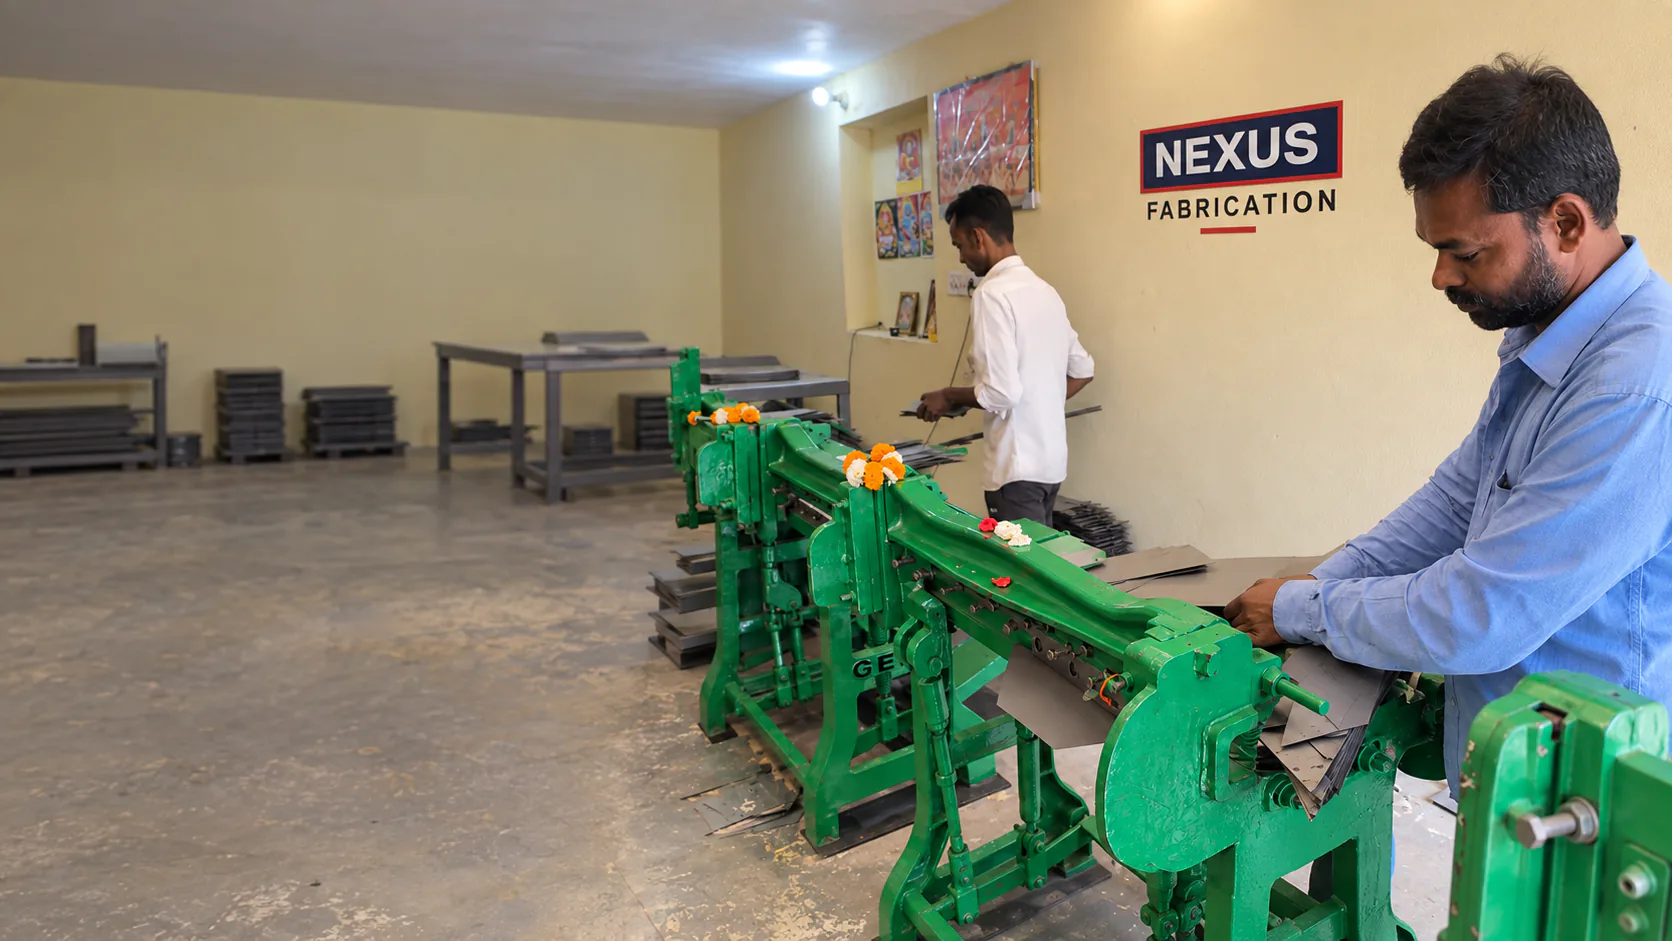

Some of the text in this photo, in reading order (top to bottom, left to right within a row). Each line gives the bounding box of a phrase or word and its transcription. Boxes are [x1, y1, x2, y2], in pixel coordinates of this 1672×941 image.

[1156, 122, 1318, 178] NEXUS
[1147, 189, 1336, 220] FABRICATION
[853, 653, 903, 677] GE
